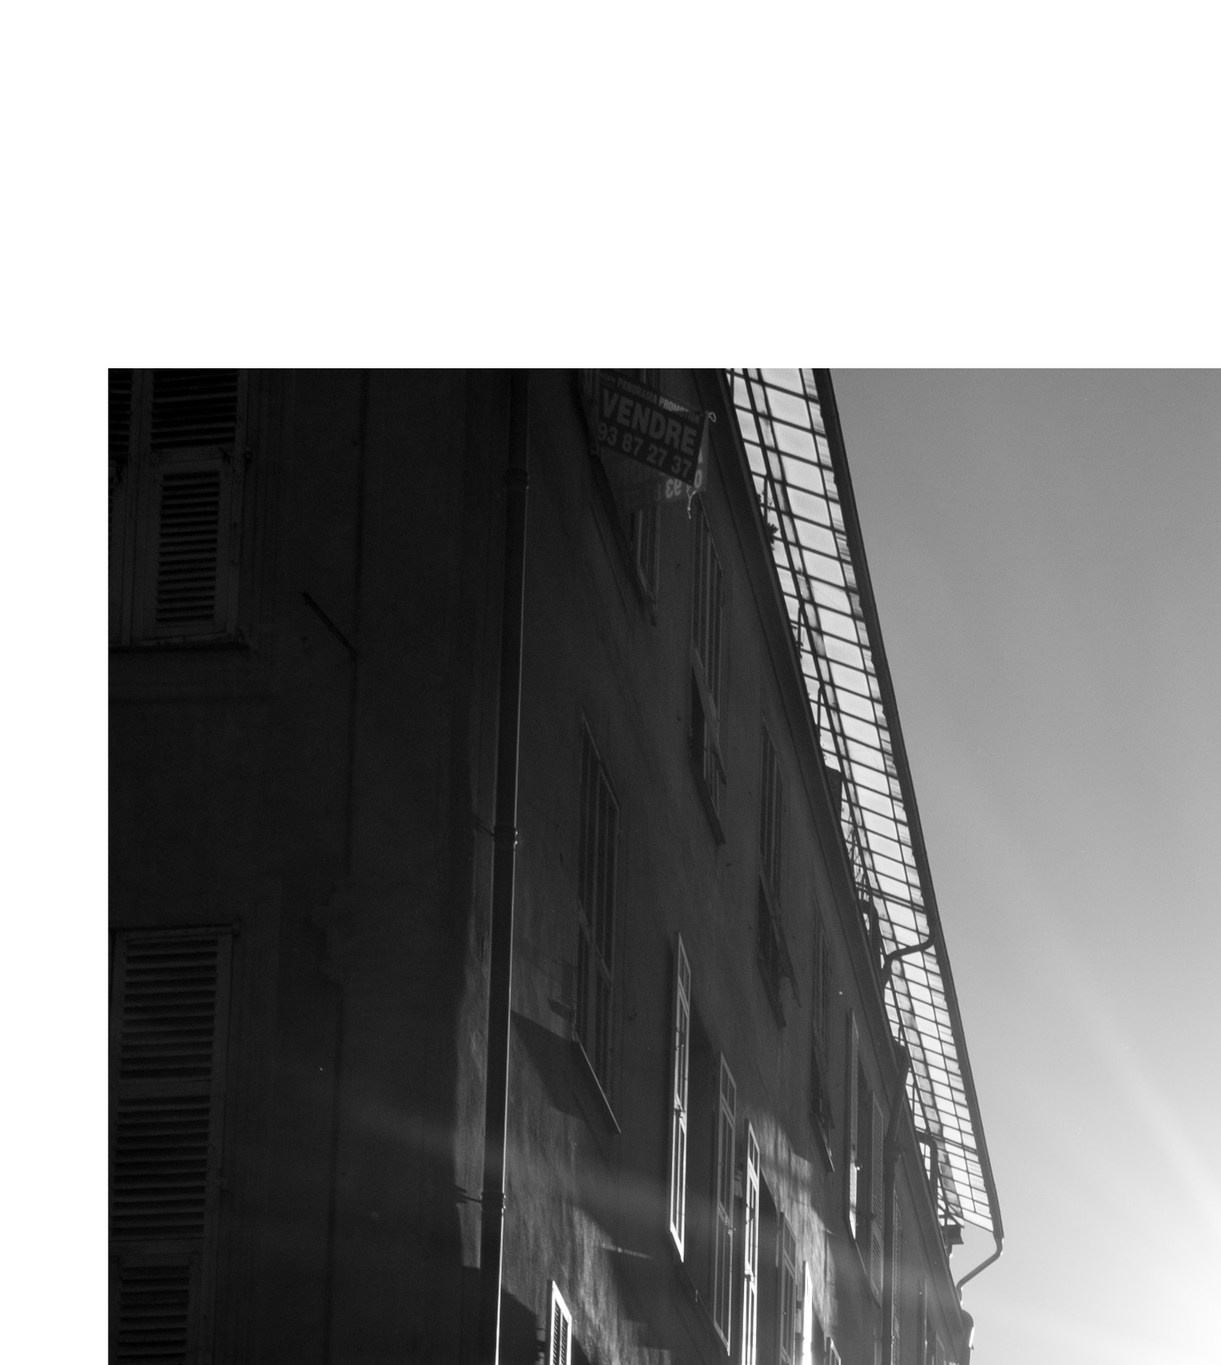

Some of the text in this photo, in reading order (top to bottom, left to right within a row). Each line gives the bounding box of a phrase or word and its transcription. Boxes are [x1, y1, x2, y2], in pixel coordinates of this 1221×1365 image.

[598, 422, 619, 447] 93
[621, 433, 644, 456] 87
[646, 444, 668, 467] 27
[671, 455, 692, 478] 37
[602, 388, 698, 456] VENDRE
